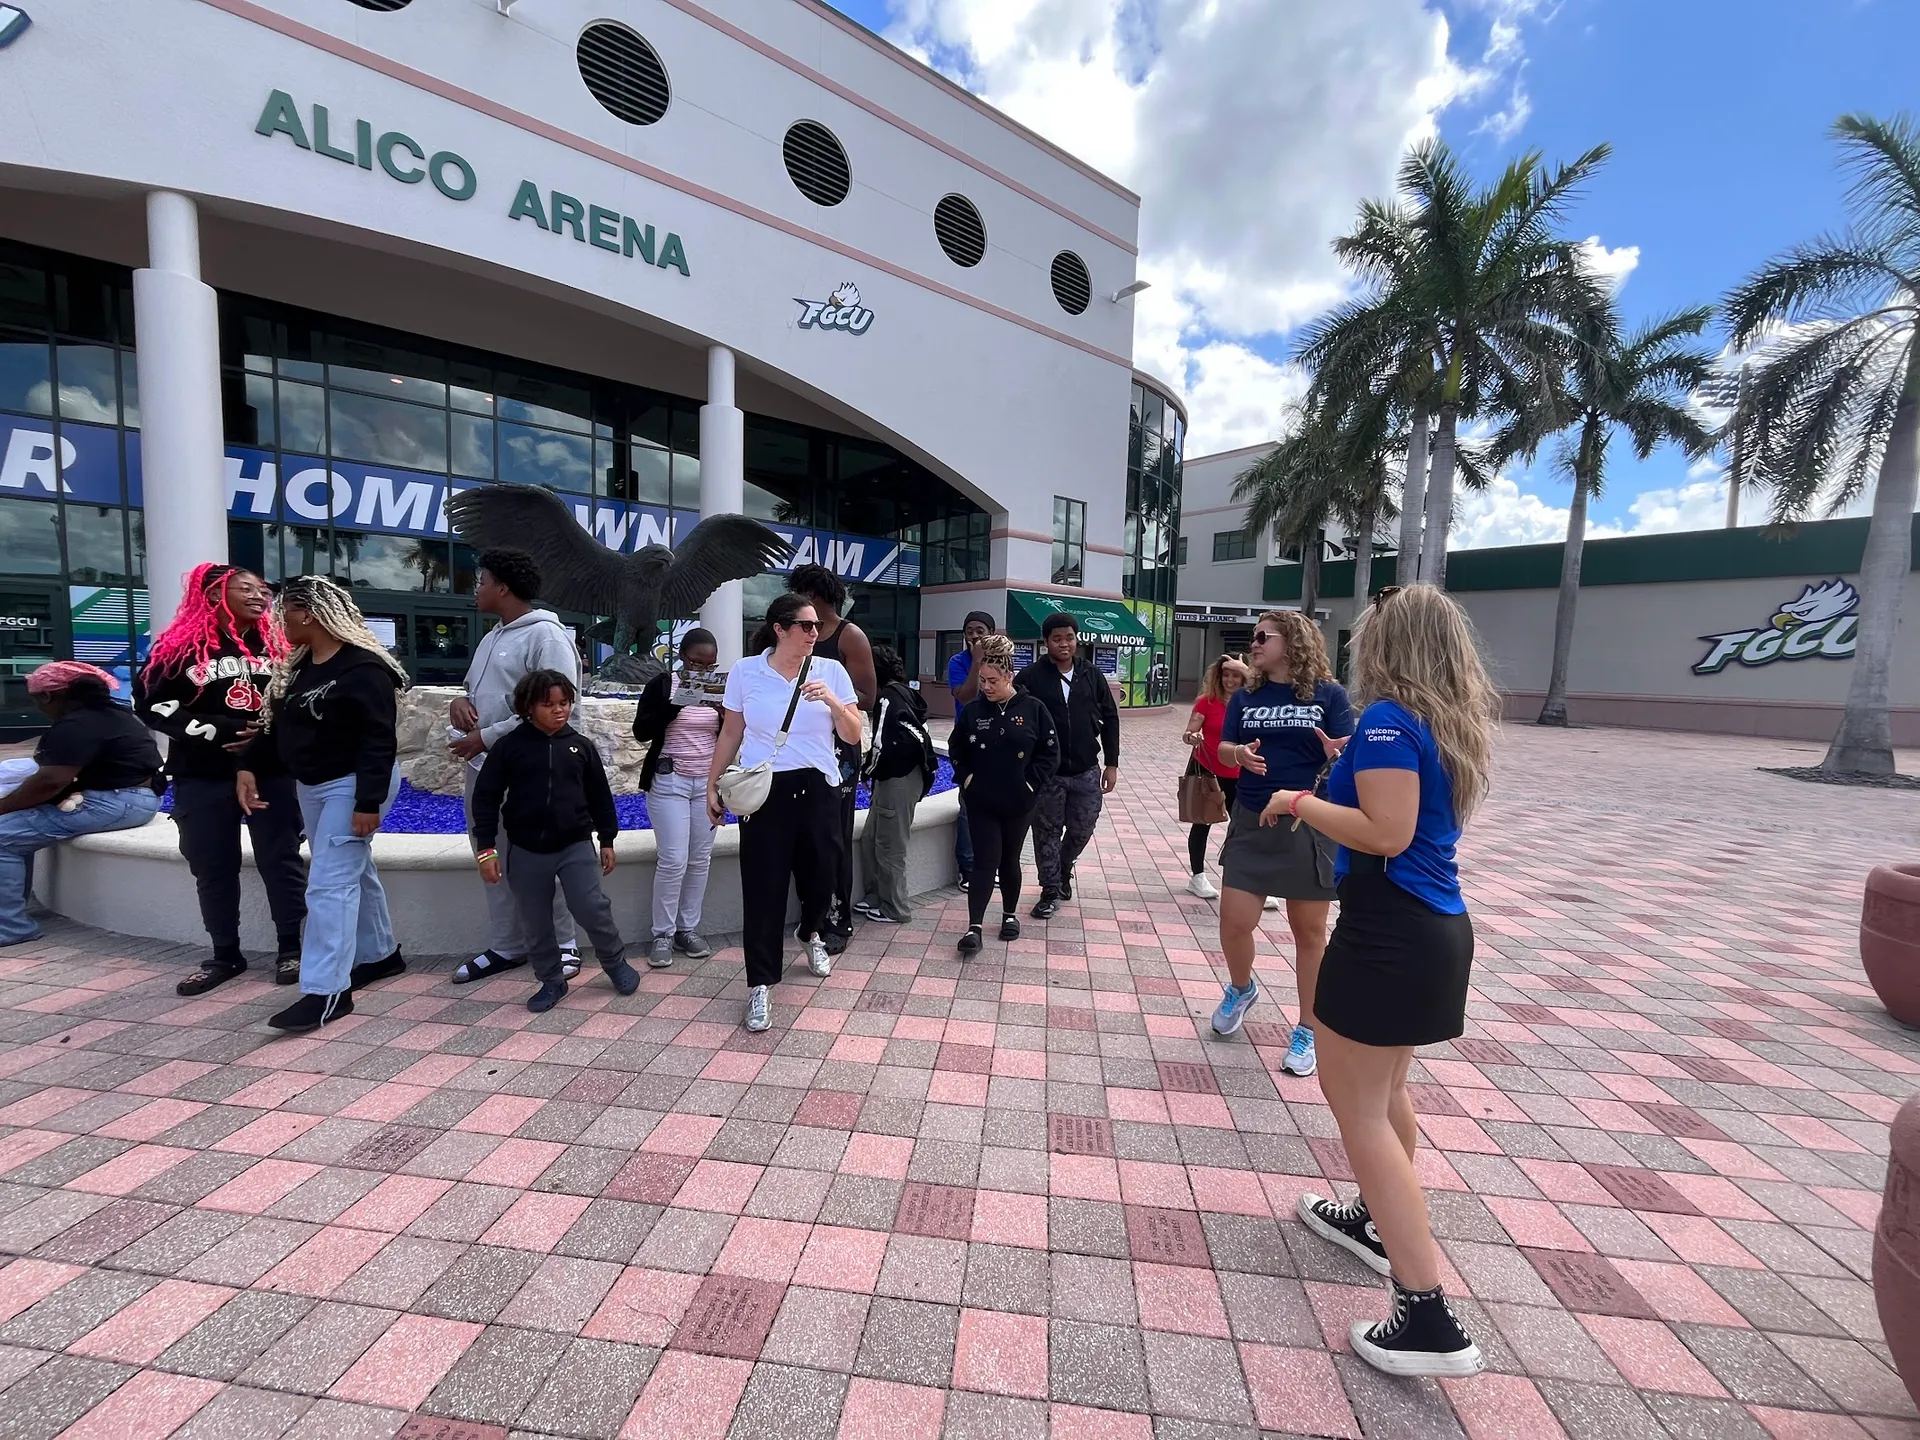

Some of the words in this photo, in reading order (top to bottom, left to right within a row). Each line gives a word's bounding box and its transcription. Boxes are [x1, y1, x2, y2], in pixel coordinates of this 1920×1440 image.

[255, 89, 477, 200] ALICO
[508, 180, 690, 276] ARENA
[792, 297, 875, 336] FGCU
[226, 456, 677, 553] HOMEWN
[764, 532, 865, 577] EAM
[1175, 613, 1198, 621] UITES
[1199, 614, 1237, 622] ENTRANCE
[1076, 631, 1098, 643] KUP
[1100, 633, 1146, 646] WINDOW
[186, 655, 273, 686] CROOK
[1243, 720, 1261, 729] FOR
[1263, 719, 1316, 729] CHILDREN
[1364, 727, 1401, 736] Welcome
[1367, 734, 1396, 742] Center
